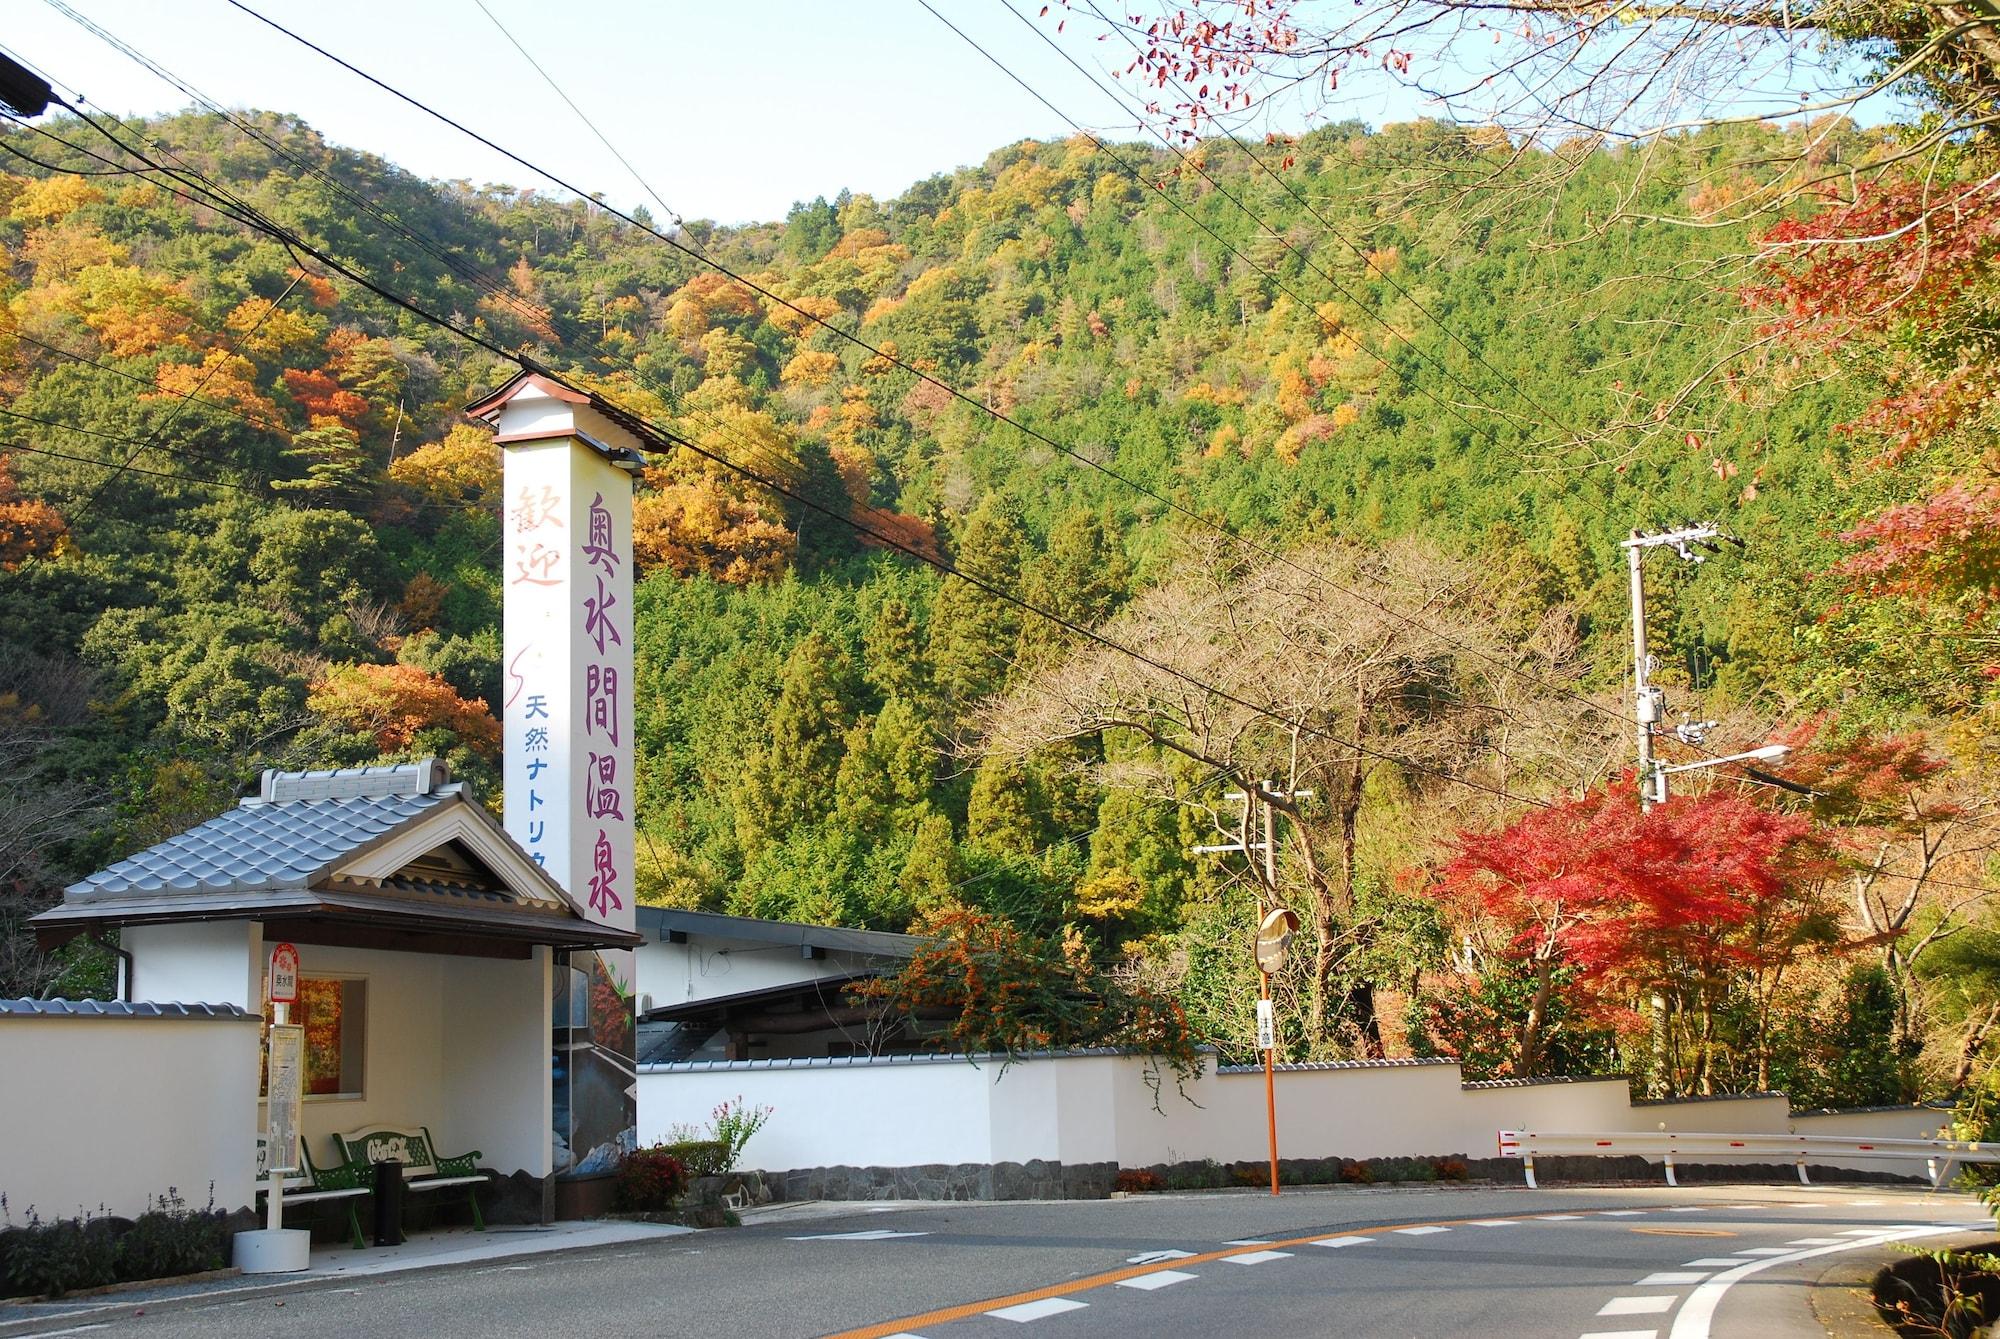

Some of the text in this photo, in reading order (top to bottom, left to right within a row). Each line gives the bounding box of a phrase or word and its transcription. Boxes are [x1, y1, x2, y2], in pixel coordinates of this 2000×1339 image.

[581, 491, 624, 918] 奥水間温泉
